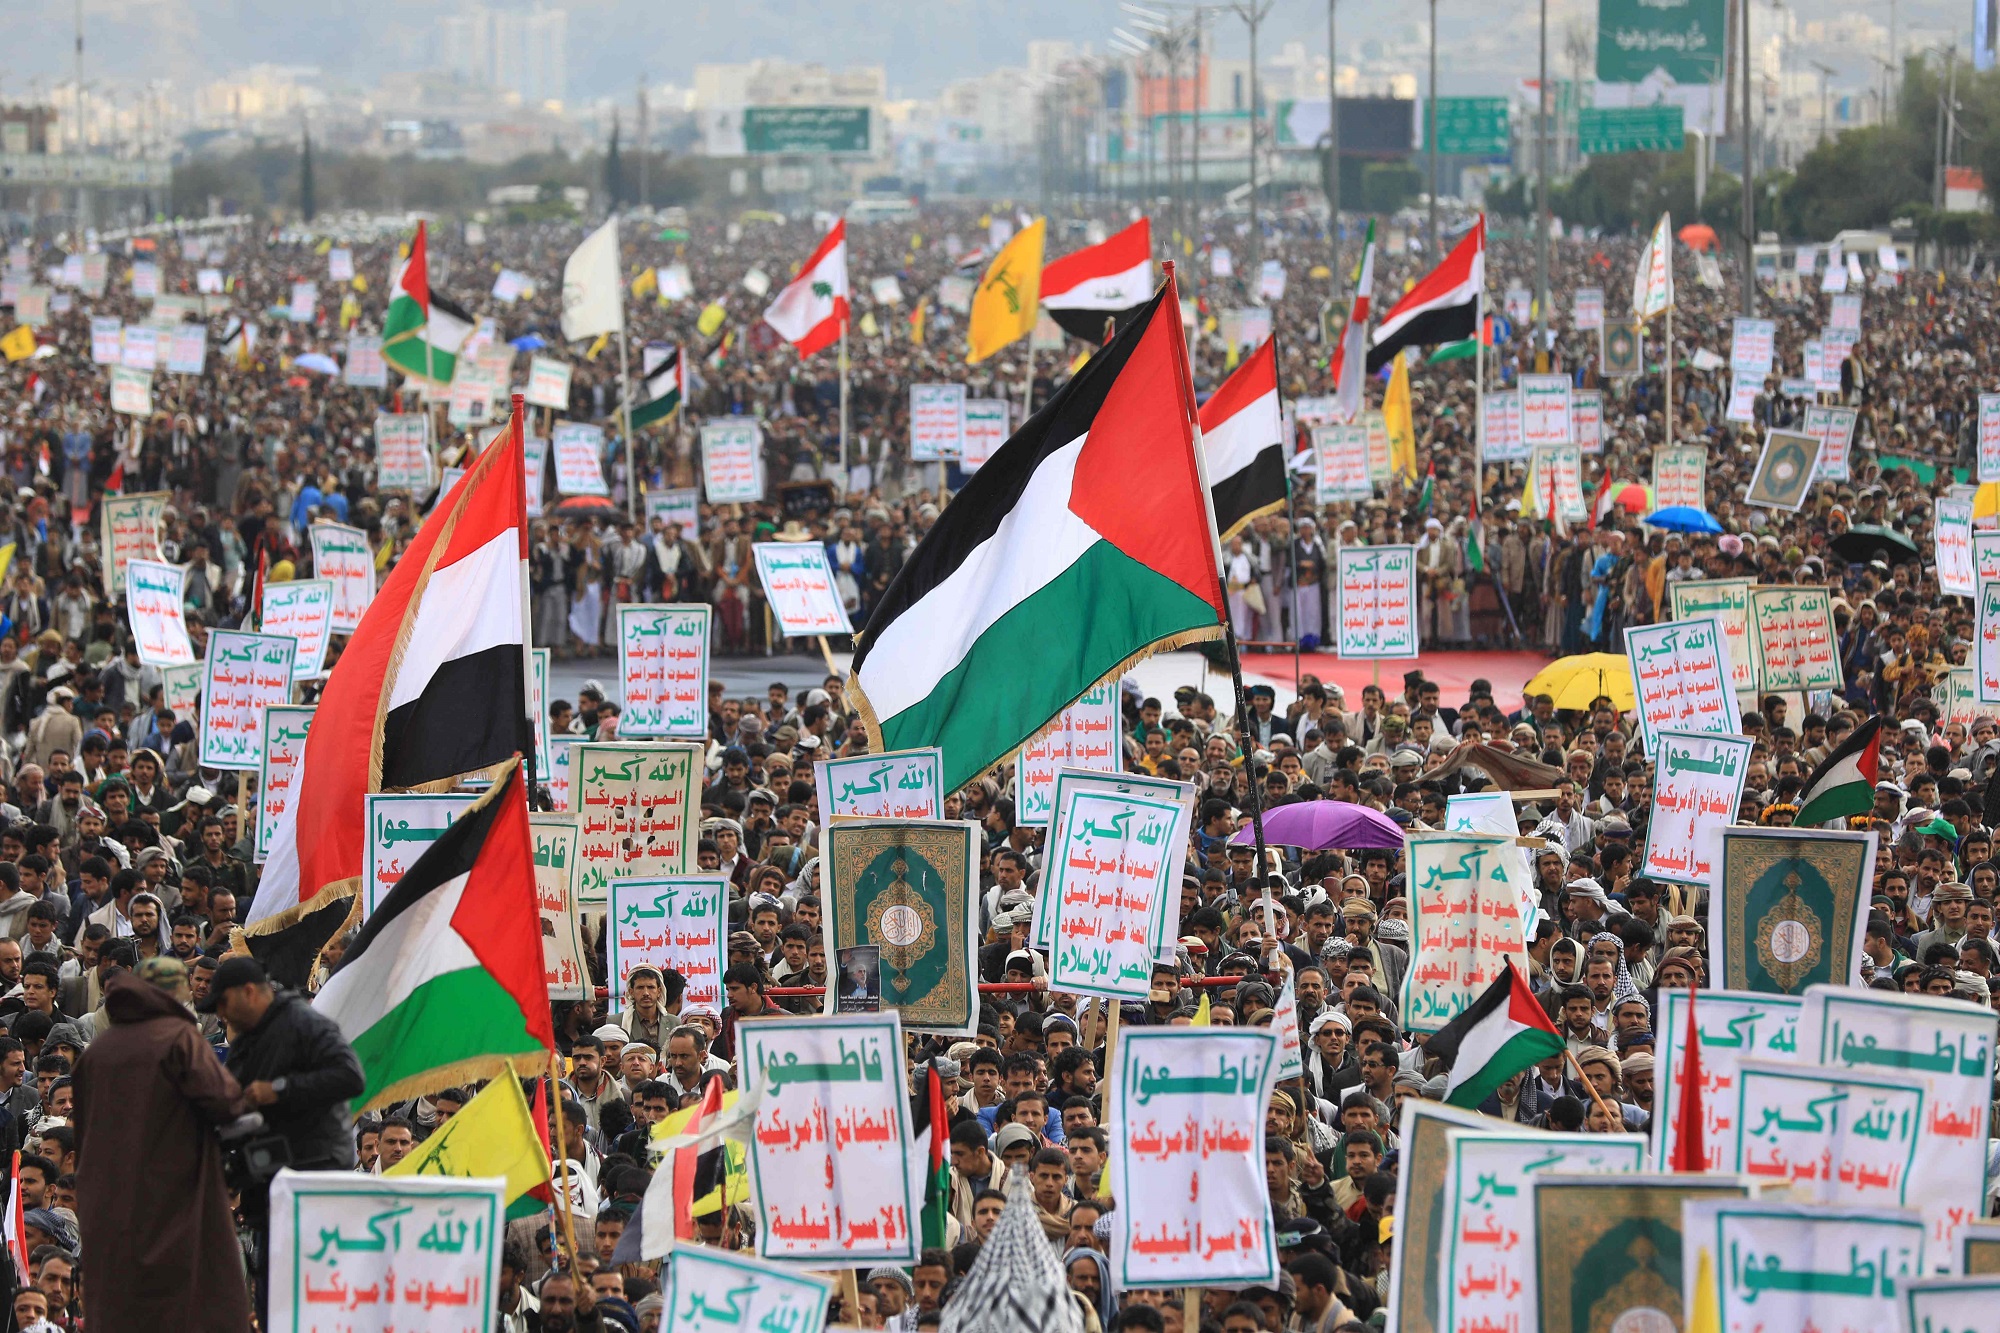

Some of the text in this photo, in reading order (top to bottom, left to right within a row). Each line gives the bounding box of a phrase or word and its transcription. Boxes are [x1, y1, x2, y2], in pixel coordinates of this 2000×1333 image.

[1344, 551, 1409, 578] الله أكبر
[1343, 575, 1409, 593] الموت لأمريكا
[1380, 596, 1409, 611] الموت
[1679, 591, 1745, 618] قاطعوا
[1761, 593, 1826, 619] الله أكبر
[626, 613, 702, 642] الله أكبر
[1760, 616, 1827, 633] الموت لأمريكا
[214, 635, 264, 668] أكبر
[263, 643, 292, 664] الله
[626, 641, 701, 662] الموت لأمريكا
[1382, 630, 1410, 651] النصر
[1636, 628, 1713, 663] الله أكبر
[1799, 636, 1830, 652] الموت
[212, 667, 287, 690] الموت لأمريكا
[626, 664, 700, 684] الموت لإسرائيل
[1639, 655, 1717, 680] الموت لأمريكا
[1806, 665, 1834, 687] النصر
[626, 686, 700, 705] اللعنة على اليهود
[1644, 677, 1720, 704] الموت لإسرائيل
[209, 715, 239, 734] اليهود
[623, 705, 700, 732] النصر للإسلام
[1647, 697, 1724, 725] اللعنة على اليهود
[1075, 715, 1112, 735] الموت
[208, 734, 248, 759] للإسلام
[1075, 741, 1112, 761] الموت
[1664, 740, 1738, 777] قاطعوا
[584, 753, 648, 788] أكبر
[648, 757, 686, 782] الله
[835, 761, 933, 805] الله أكبر
[1024, 766, 1054, 788] ليهود
[584, 787, 682, 812] الموت لأمريكا
[894, 797, 933, 818] الموت
[1655, 781, 1735, 820] البضائع الأمريكية
[583, 813, 681, 838] الموت لإسرائيل
[1072, 805, 1168, 847] الله أكبر
[1687, 817, 1695, 840] و
[533, 834, 567, 868] قاط
[582, 841, 619, 862] اليهود
[647, 840, 680, 858] اللعنة
[1068, 847, 1160, 881] الموت لأمريكا
[1418, 845, 1489, 891] أكبر
[618, 886, 717, 928] الله أكبر
[1063, 881, 1154, 914] الموت لإسرائيل
[1420, 888, 1479, 920] لأمريكا
[620, 924, 716, 952] الموت لأمريكا
[1061, 917, 1102, 942] اليهود
[1421, 927, 1524, 957] لموت لإسرائيل
[675, 956, 717, 981] الموت
[1059, 944, 1112, 985] للإسلام
[1413, 961, 1484, 988] على اليهود
[1832, 1018, 1988, 1078] قاطعوا
[745, 1036, 884, 1098] قاطعوا
[757, 1096, 898, 1155] البضائع الأمريكية
[1748, 1084, 1910, 1144] الله أكبر
[1130, 1111, 1199, 1163] الأمريكية
[825, 1154, 834, 1189] و
[1746, 1145, 1900, 1192] الموت لأمريكا
[1190, 1169, 1198, 1203] و
[304, 1199, 483, 1267] الله أكبر
[305, 1264, 479, 1312] الموت لأمريكا
